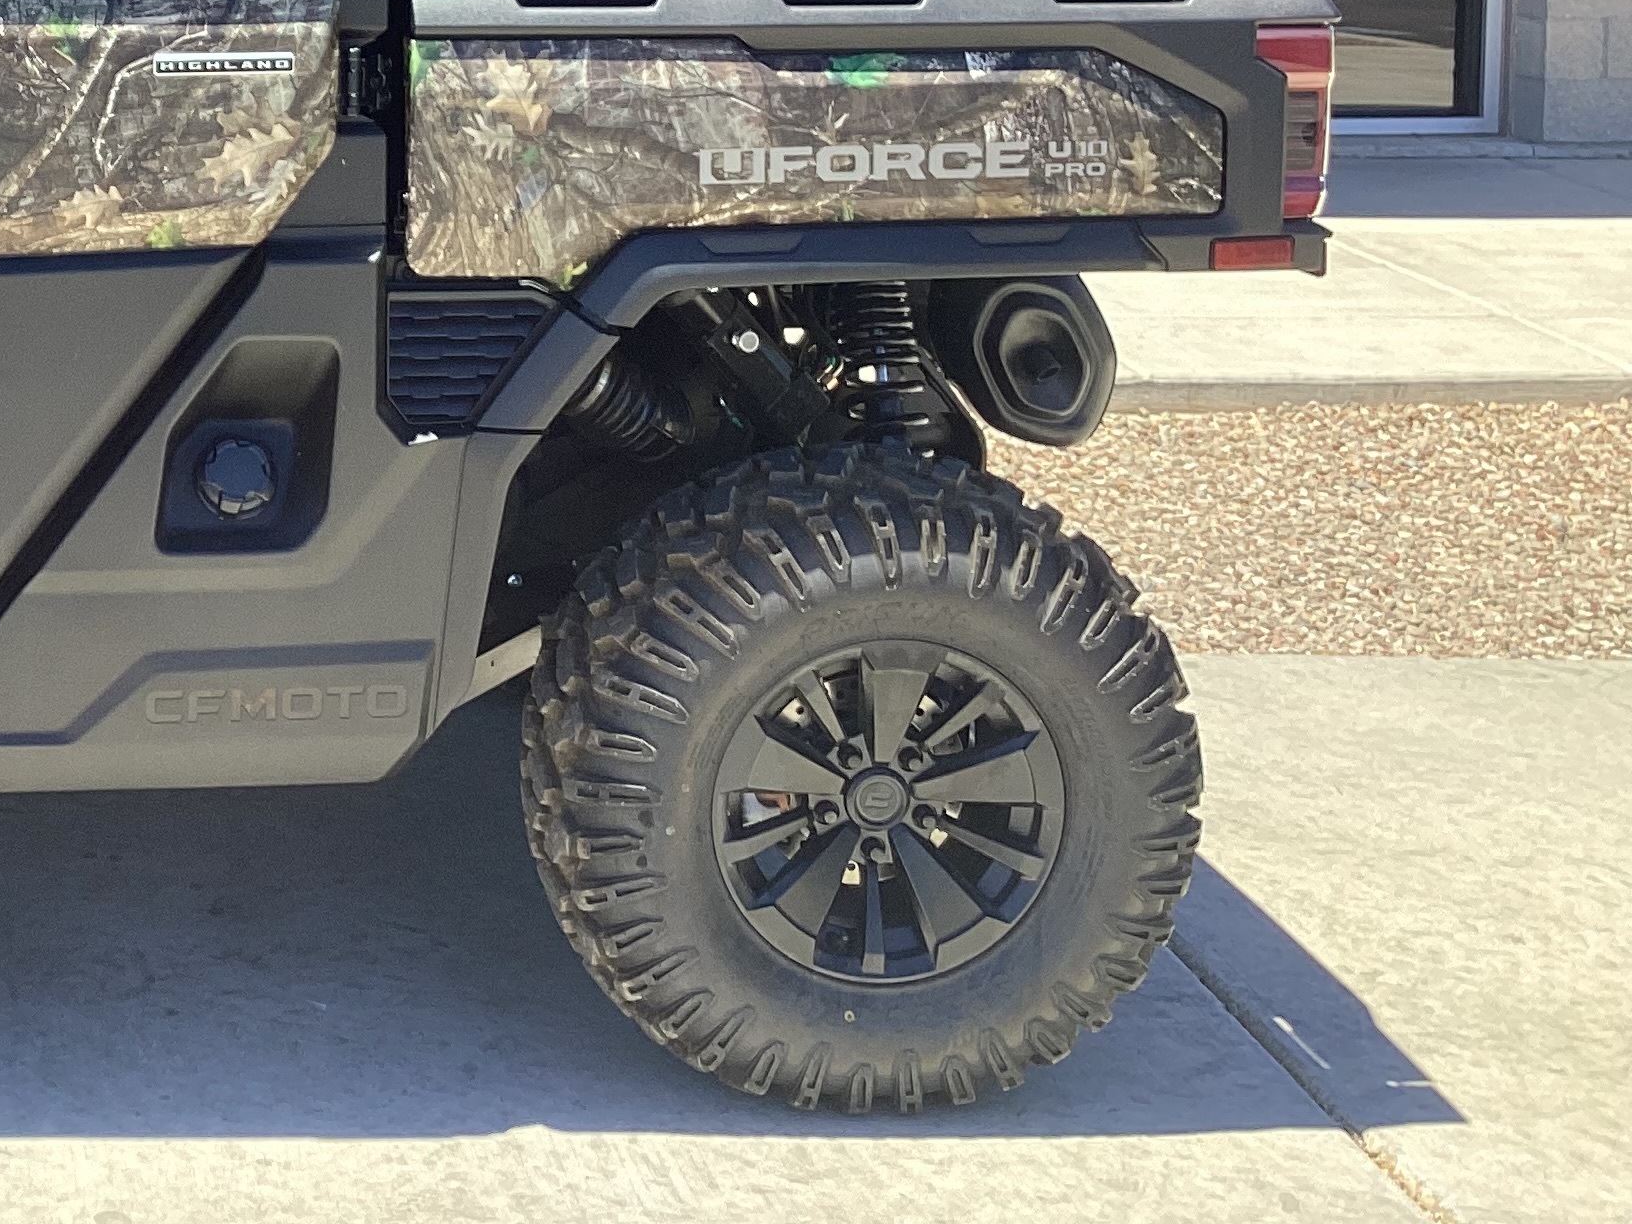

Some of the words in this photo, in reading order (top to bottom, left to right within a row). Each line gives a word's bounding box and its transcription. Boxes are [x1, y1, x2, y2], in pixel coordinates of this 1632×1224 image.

[159, 60, 289, 71] HIGHLAND
[1044, 161, 1106, 177] PRO
[144, 684, 408, 724] CFMOTO
